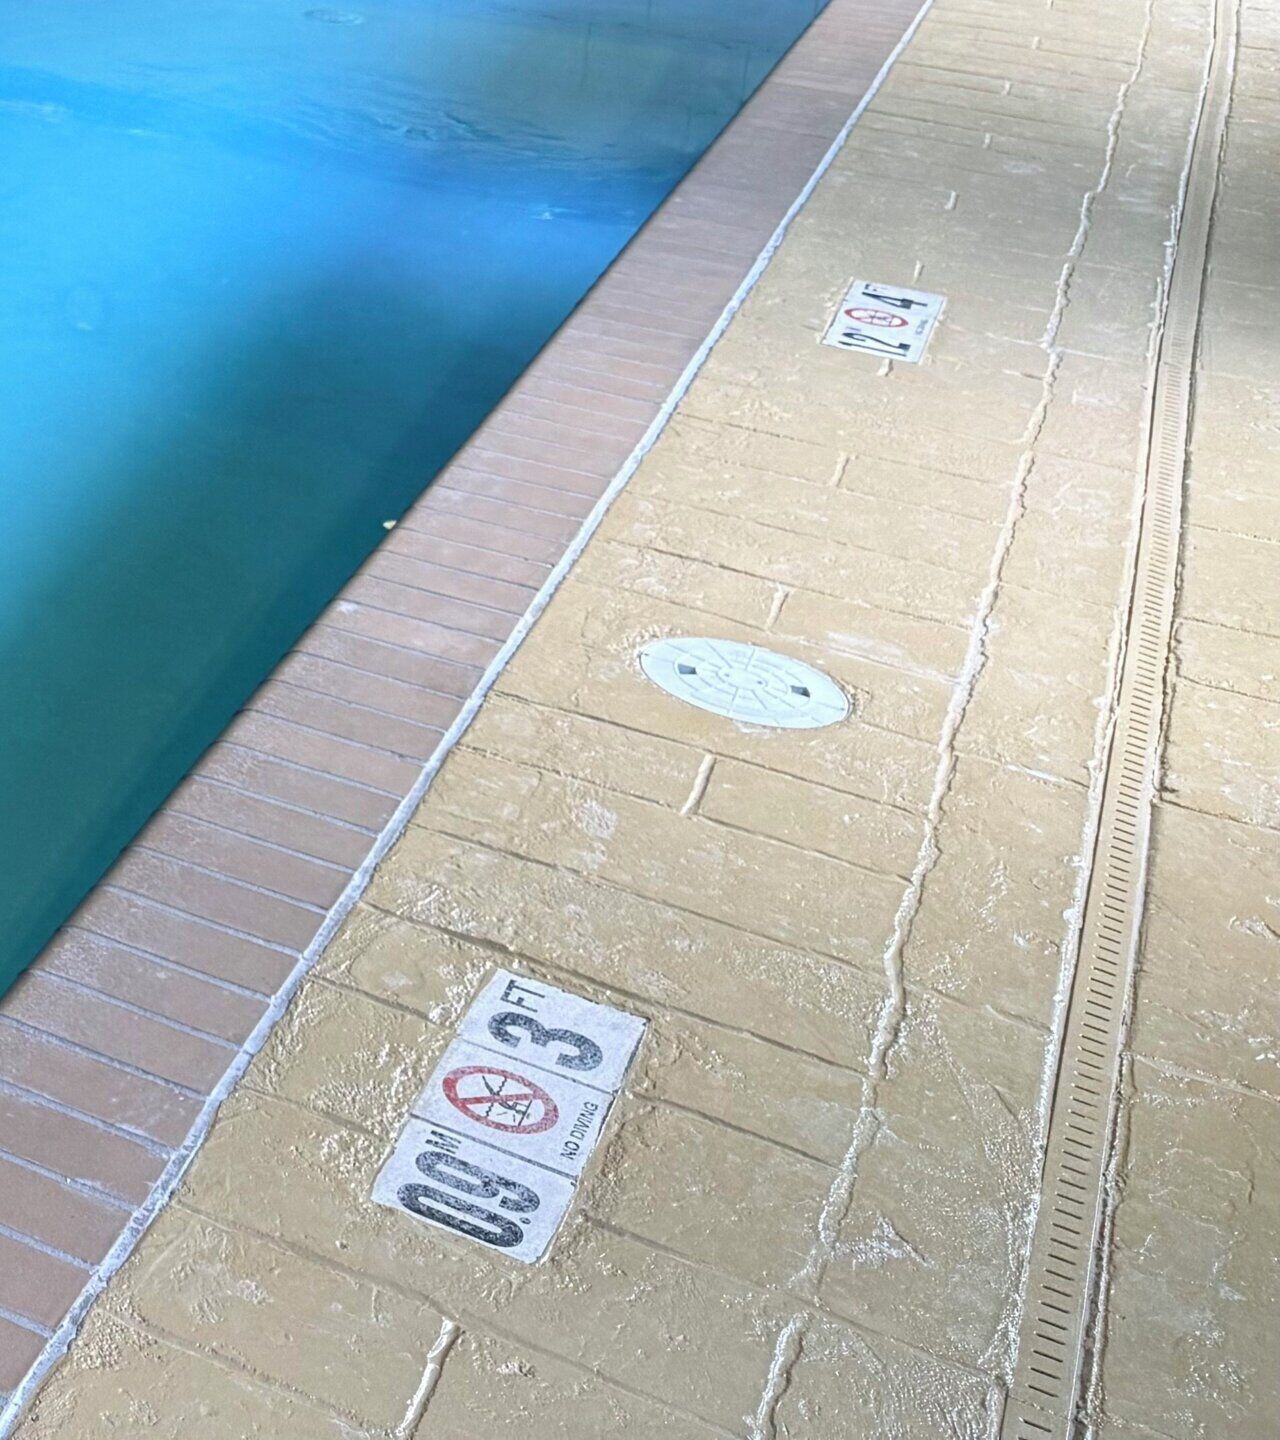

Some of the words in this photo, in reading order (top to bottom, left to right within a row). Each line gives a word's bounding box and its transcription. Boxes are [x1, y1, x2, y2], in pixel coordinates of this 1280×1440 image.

[500, 979, 546, 1013] FT
[487, 1011, 603, 1072] 3
[425, 1129, 462, 1155] M
[560, 1140, 580, 1161] NO
[573, 1101, 599, 1142] DIVING
